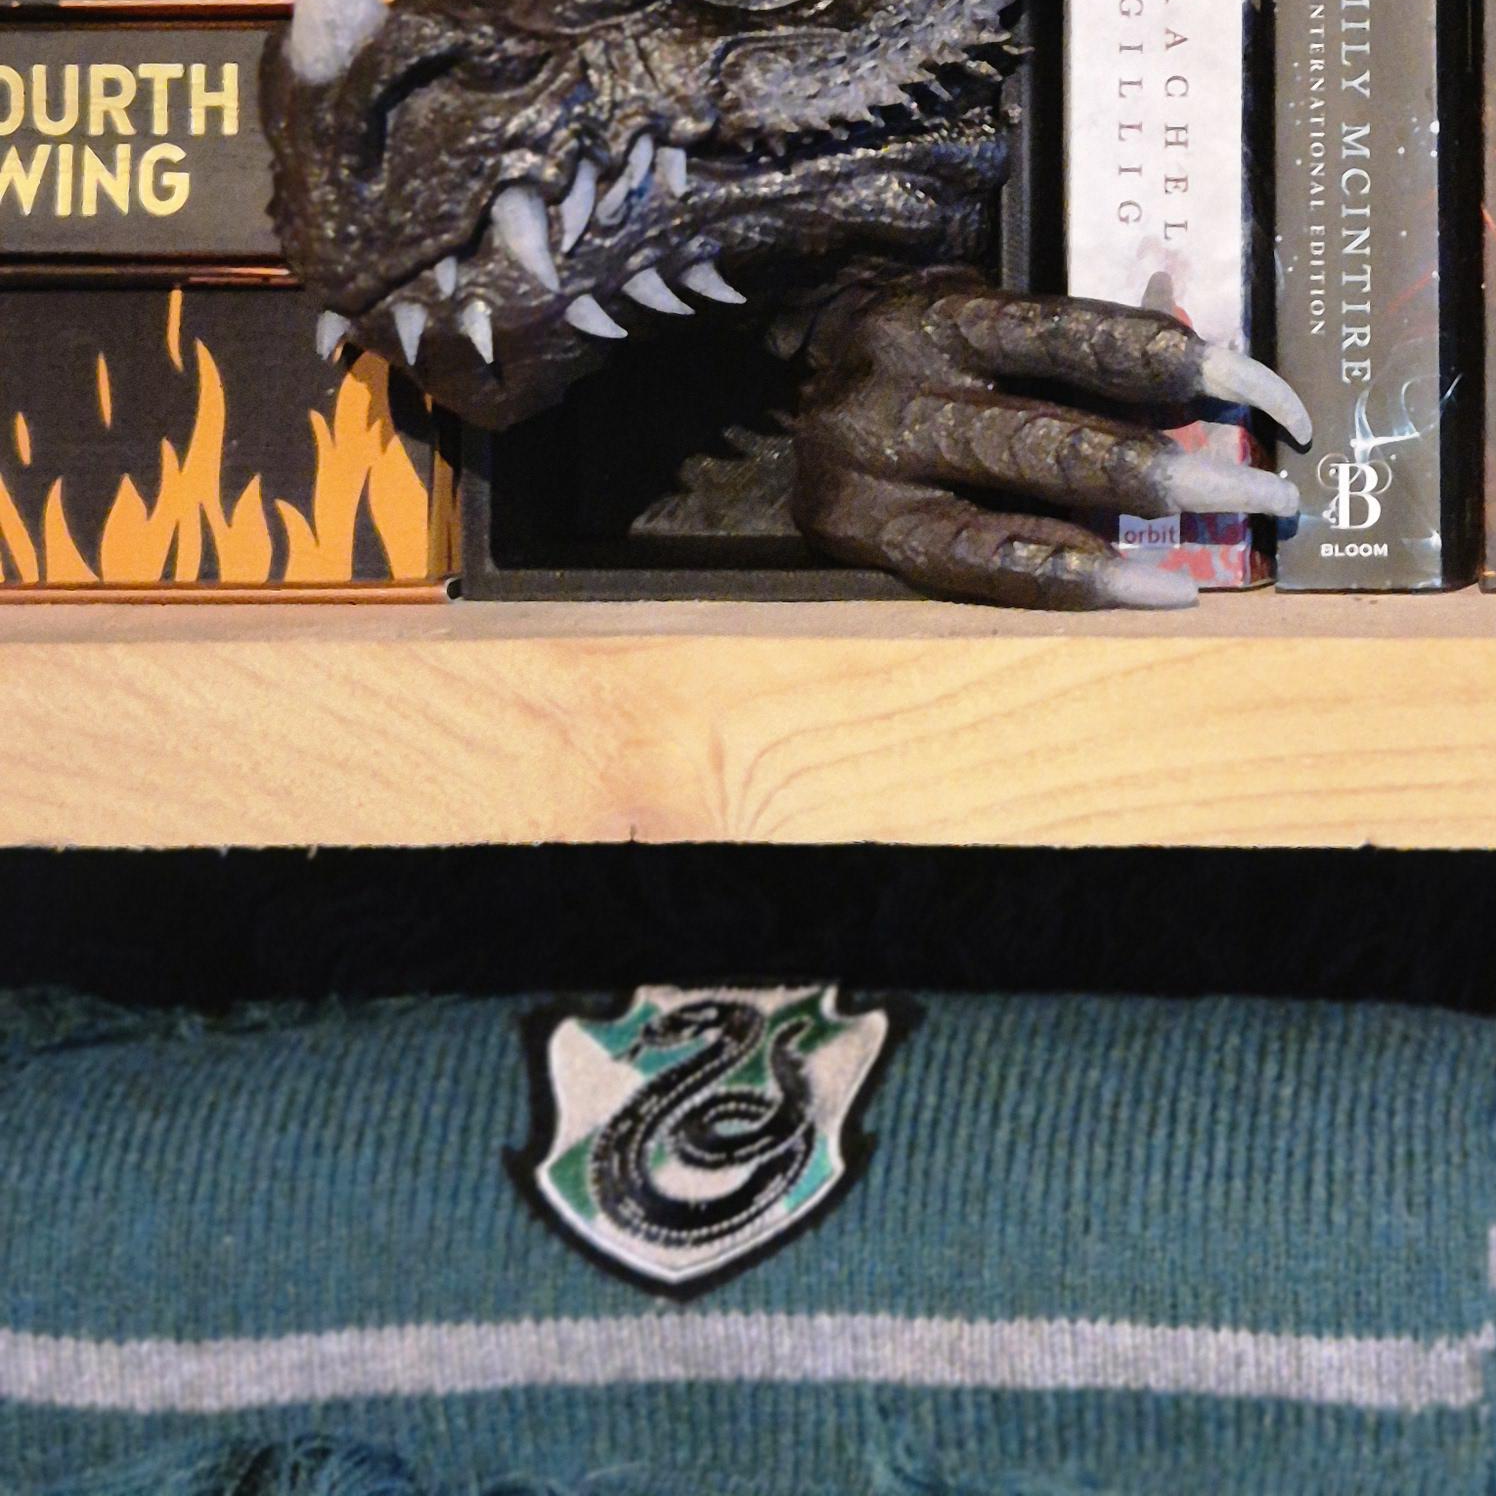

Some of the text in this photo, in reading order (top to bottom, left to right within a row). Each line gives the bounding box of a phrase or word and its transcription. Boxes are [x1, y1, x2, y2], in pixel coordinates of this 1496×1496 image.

[0, 142, 190, 217] WING
[1309, 225, 1326, 335] EDITION
[1341, 122, 1372, 385] MCINTIRE
[1123, 517, 1177, 544] orbit
[1320, 543, 1389, 558] BLOOM
